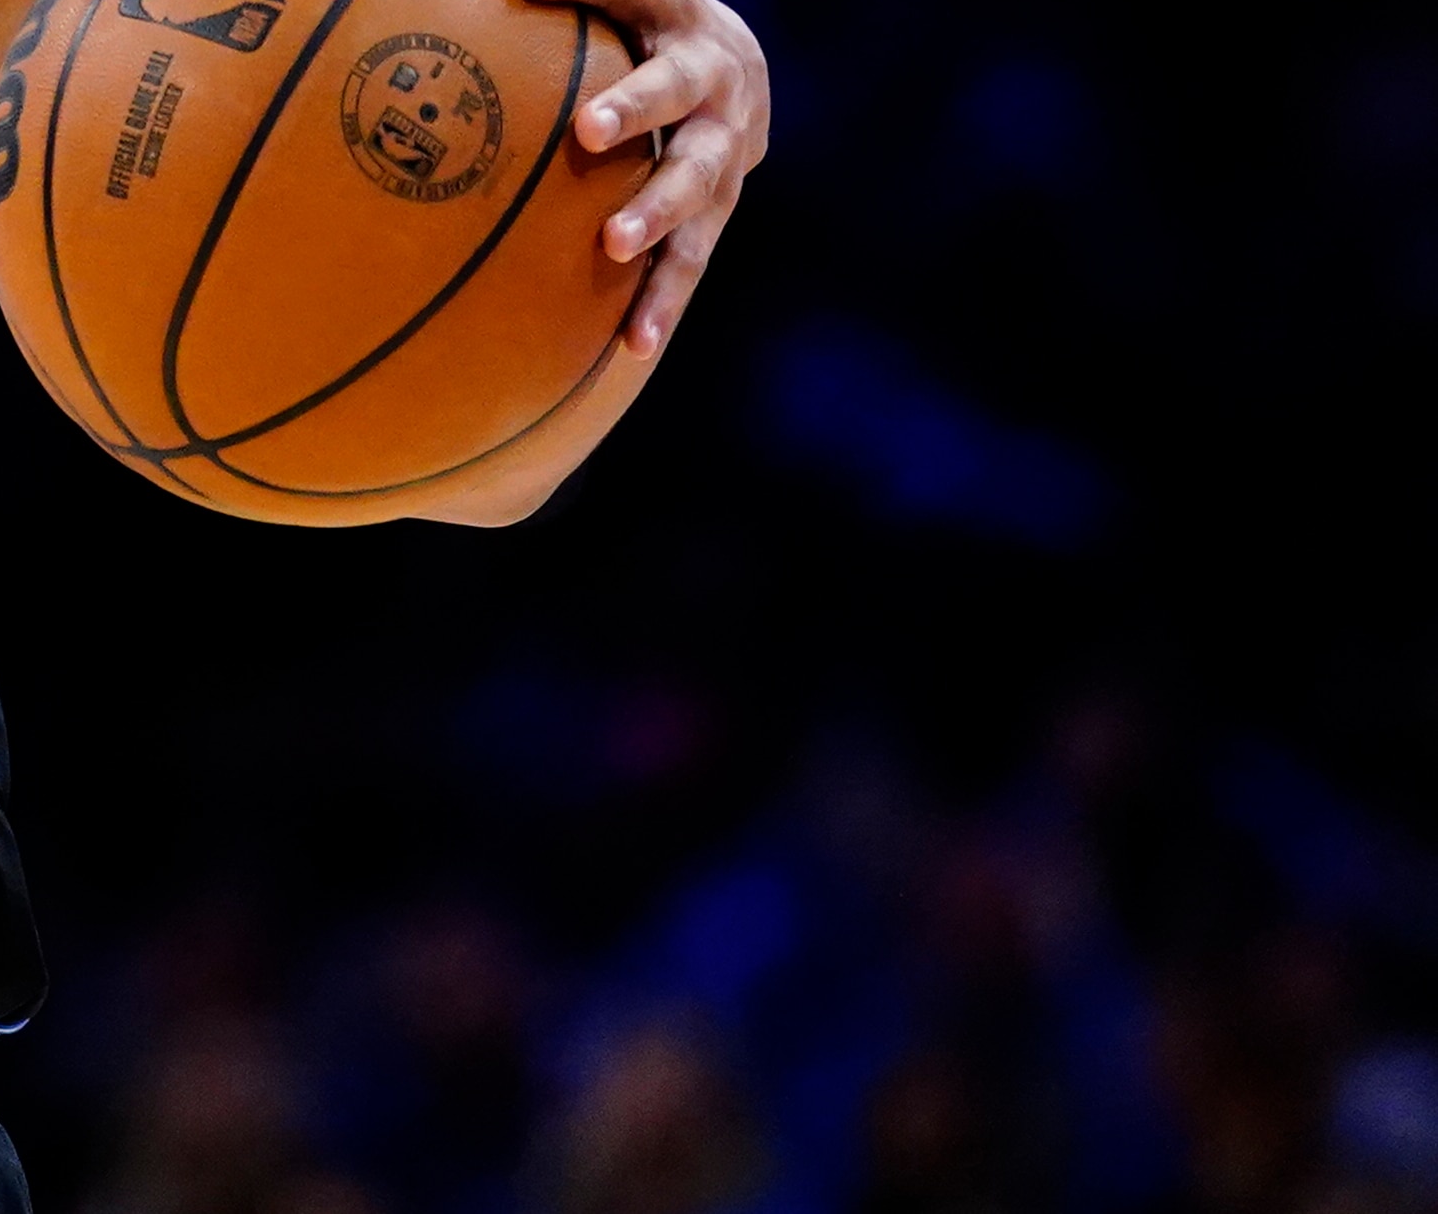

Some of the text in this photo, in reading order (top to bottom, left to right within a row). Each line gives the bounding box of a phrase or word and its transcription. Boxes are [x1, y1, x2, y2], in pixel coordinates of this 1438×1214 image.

[106, 50, 174, 199] OFFICIAL GAME BALL
